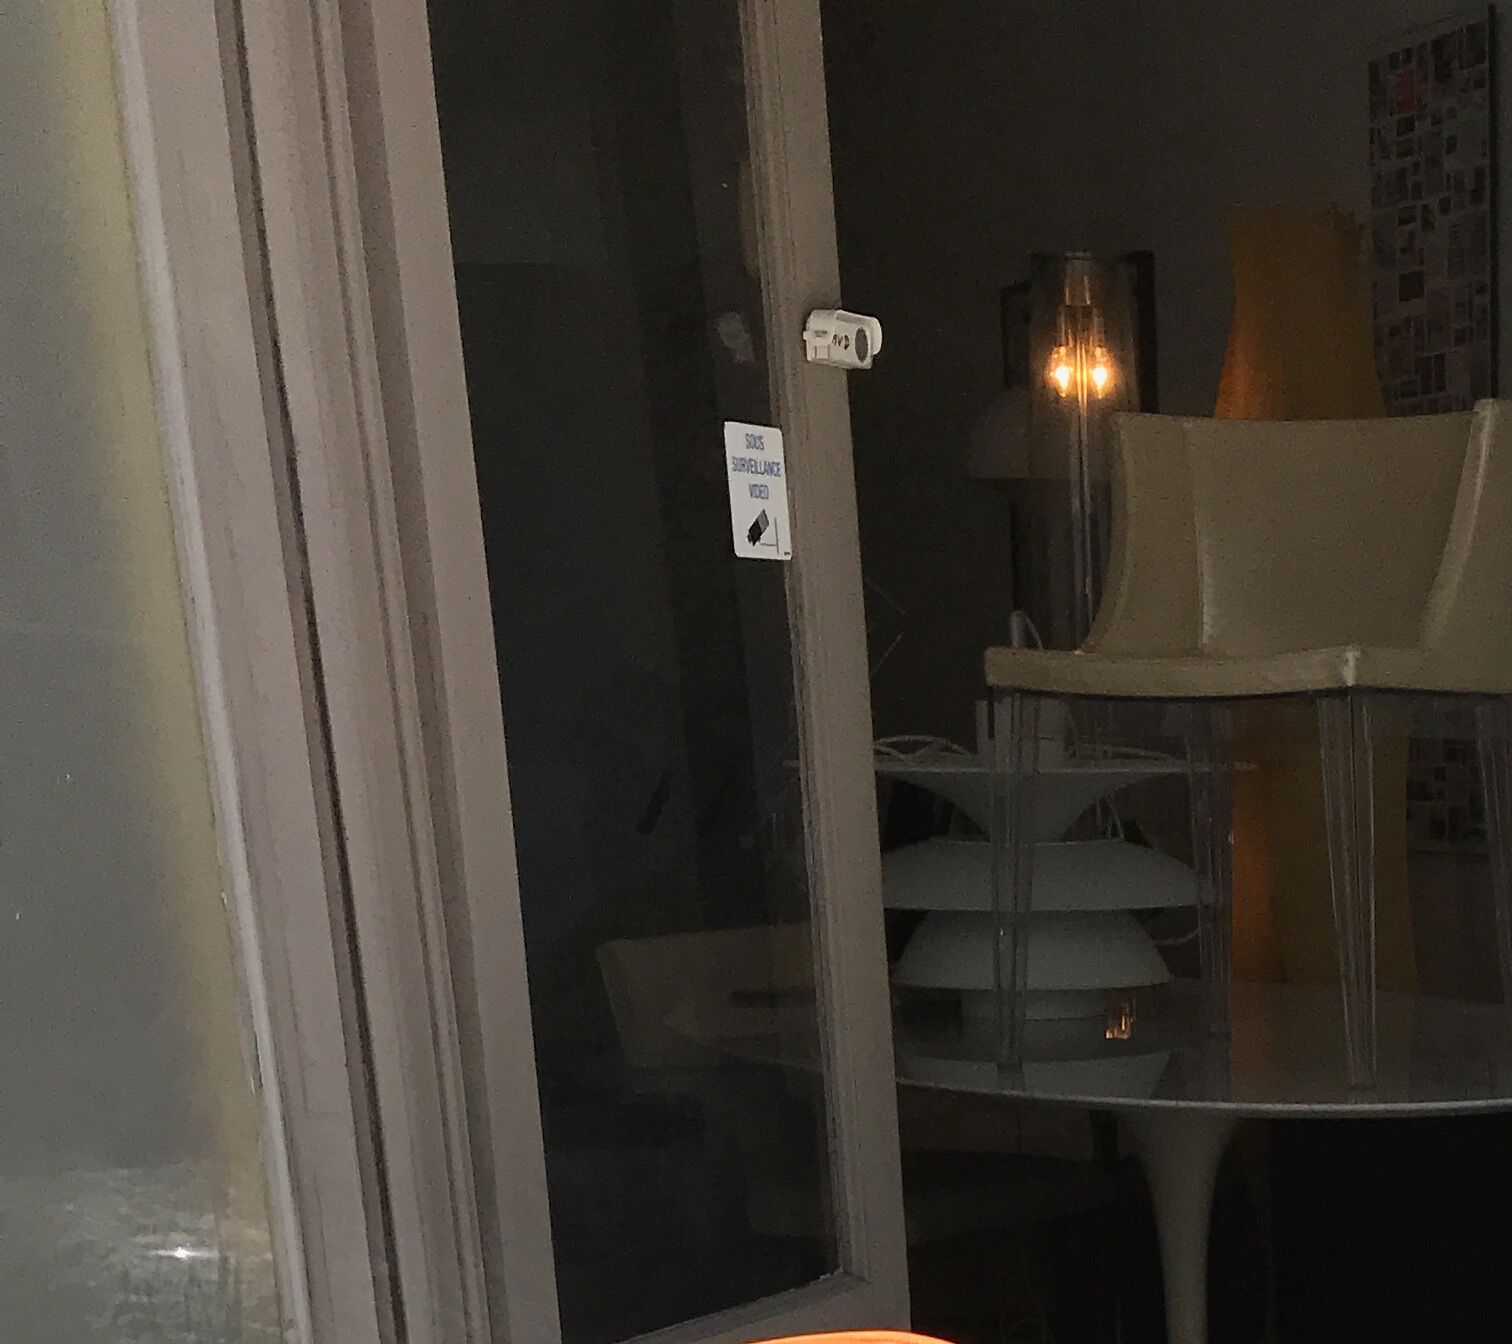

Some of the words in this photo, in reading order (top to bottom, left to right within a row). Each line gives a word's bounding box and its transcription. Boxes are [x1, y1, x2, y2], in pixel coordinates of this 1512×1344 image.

[745, 433, 765, 451] SOUS
[732, 456, 782, 478] SURVEILLANCE
[748, 482, 770, 500] VIDEO
